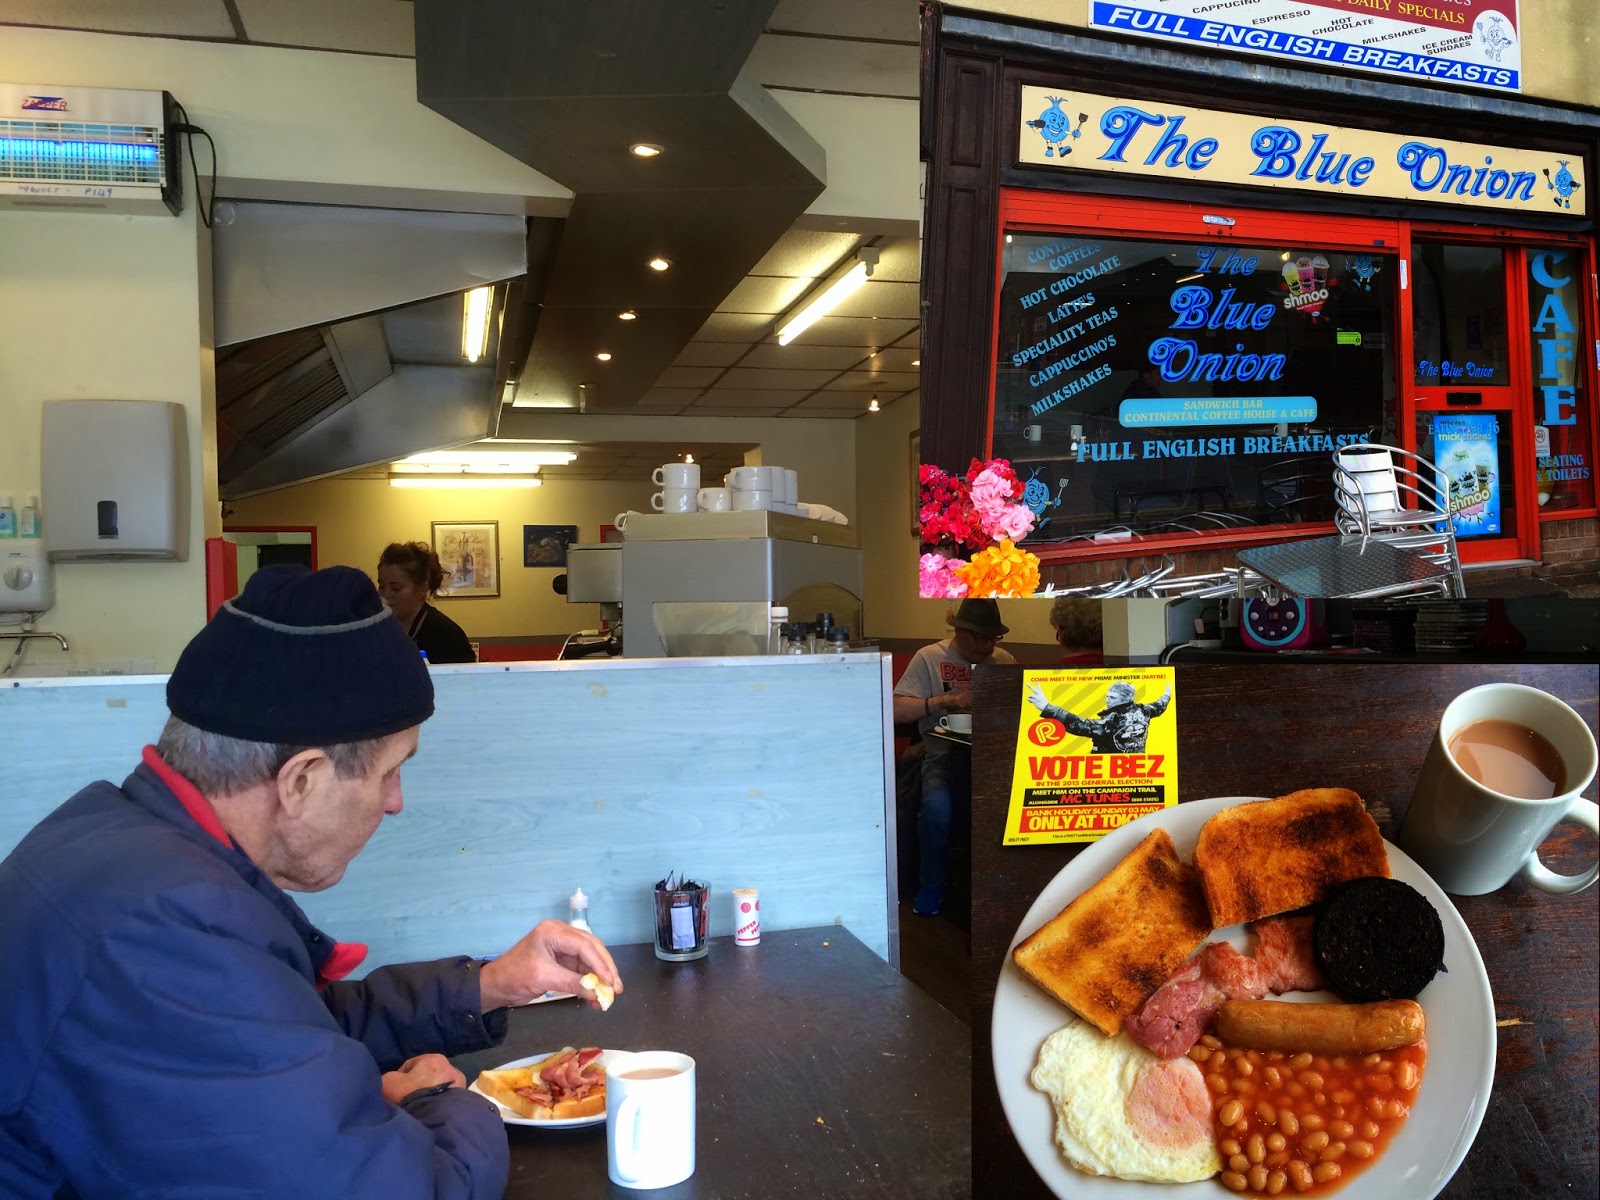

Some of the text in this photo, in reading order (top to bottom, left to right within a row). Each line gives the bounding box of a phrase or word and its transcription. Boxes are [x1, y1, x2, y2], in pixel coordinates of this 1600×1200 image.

[1251, 9, 1311, 25] ESPRESSO
[1331, 17, 1353, 26] HOT
[1398, 2, 1465, 24] SPECIALS
[1312, 19, 1375, 36] CHOCOLATE
[1362, 27, 1427, 45] MILKSHAKES
[1108, 7, 1512, 86] FULL ENGLISH BREAKFASTS
[1422, 35, 1474, 51] ICE CREAM
[1427, 41, 1472, 56] SUNDAES
[1096, 104, 1537, 201] The Blue Onion
[1194, 246, 1260, 276] The
[1019, 255, 1121, 310] HOT CHOCOLATE
[1047, 292, 1096, 325] LATTE'S
[1168, 285, 1276, 331] Blue
[1284, 288, 1330, 310] shmoo
[1012, 306, 1119, 367] SPECIALITY TEAS
[1531, 250, 1577, 426] CAFE
[1029, 334, 1117, 387] CAPPUCCINO'S
[1147, 336, 1287, 383] Onion
[1419, 360, 1494, 378] The Blue Onion
[1030, 363, 1112, 416] MILKSHAKES
[1183, 400, 1263, 410] SANDWICH BAR
[1124, 408, 1315, 423] CONTINENTAL COFFEE HOUSE & CAFE
[1076, 432, 1370, 463] FULL ENGLISH BREAKFASTS
[1538, 454, 1585, 468] SEATING
[1546, 467, 1590, 482] TOILETS
[1450, 489, 1491, 512] shmoo
[1028, 755, 1165, 780] VOTE BEZ
[1060, 794, 1083, 804] MC
[1089, 793, 1130, 804] TUNES
[1096, 786, 1137, 794] CAMPAIGN
[1053, 808, 1092, 816] HOLIDAY
[1092, 807, 1128, 815] SUNDAY
[1029, 816, 1074, 831] ONLY
[1074, 815, 1097, 829] AT
[737, 920, 756, 935] PEPPER
